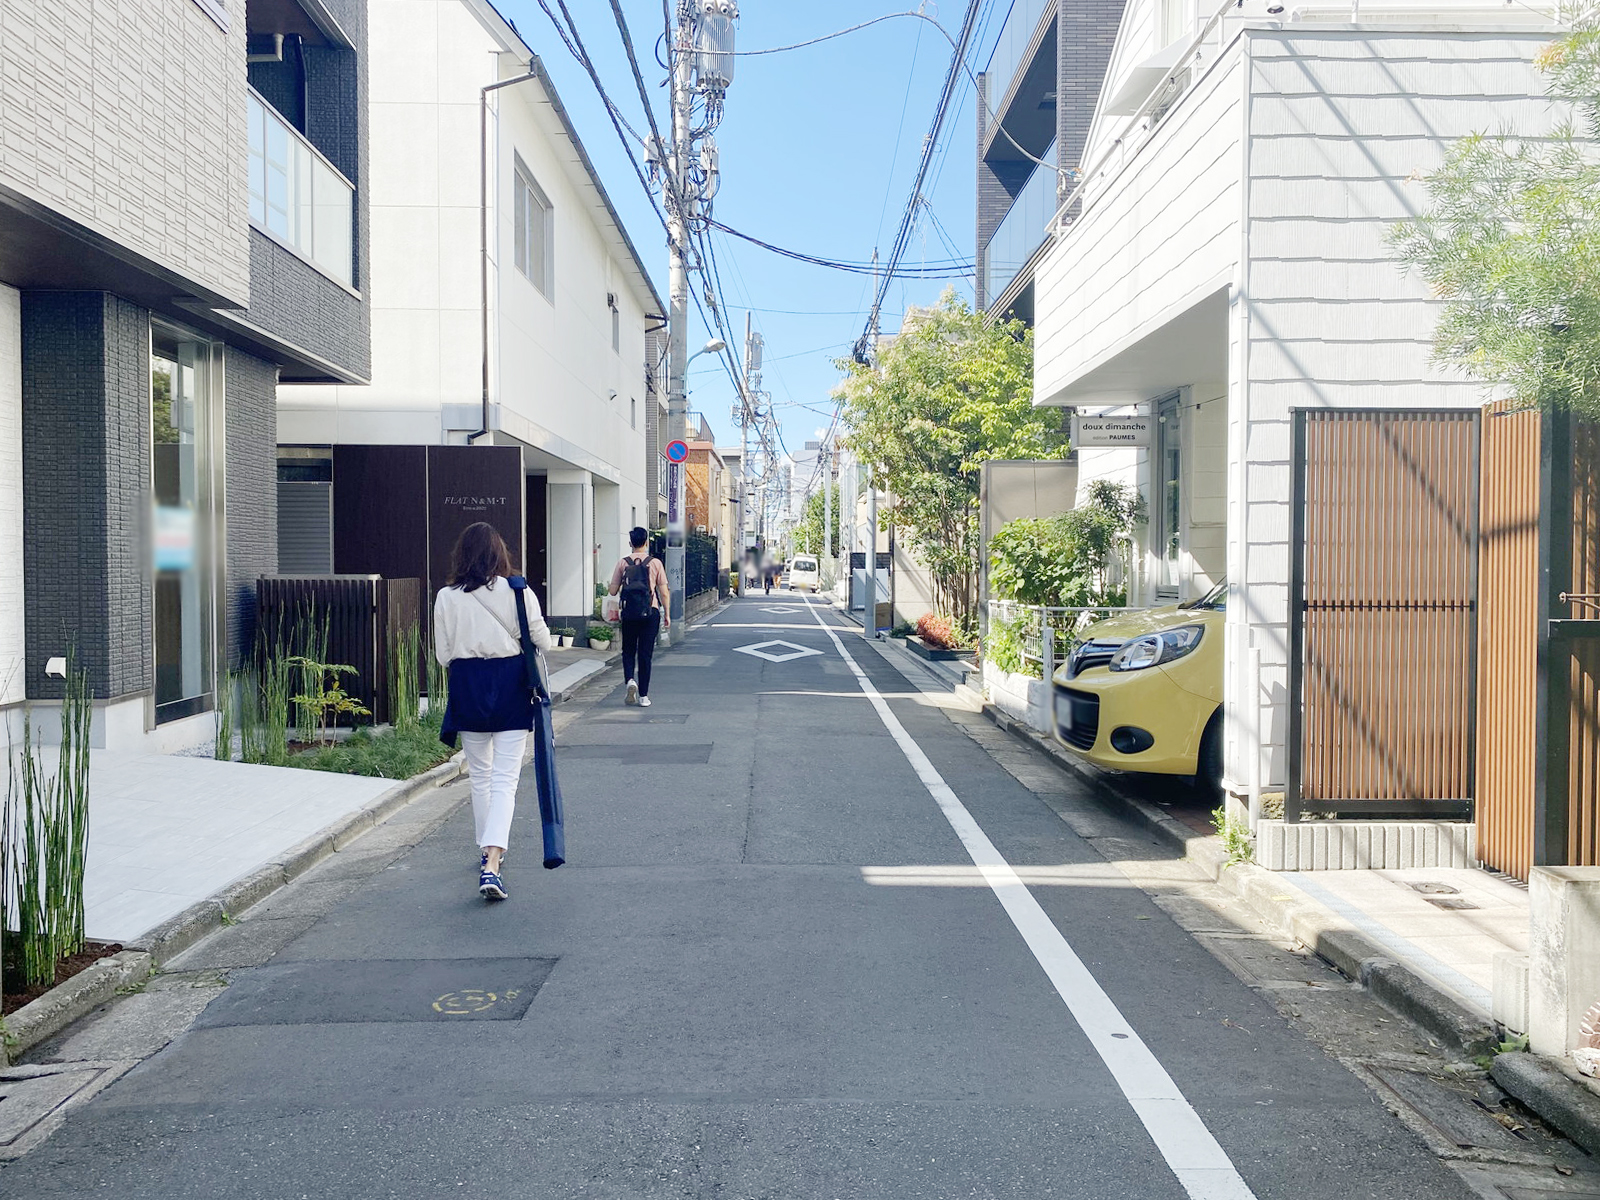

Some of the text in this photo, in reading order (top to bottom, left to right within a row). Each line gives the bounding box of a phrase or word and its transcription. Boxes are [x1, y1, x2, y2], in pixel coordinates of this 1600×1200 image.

[1082, 423, 1146, 431] doux dimanche
[444, 496, 468, 505] FLAT
